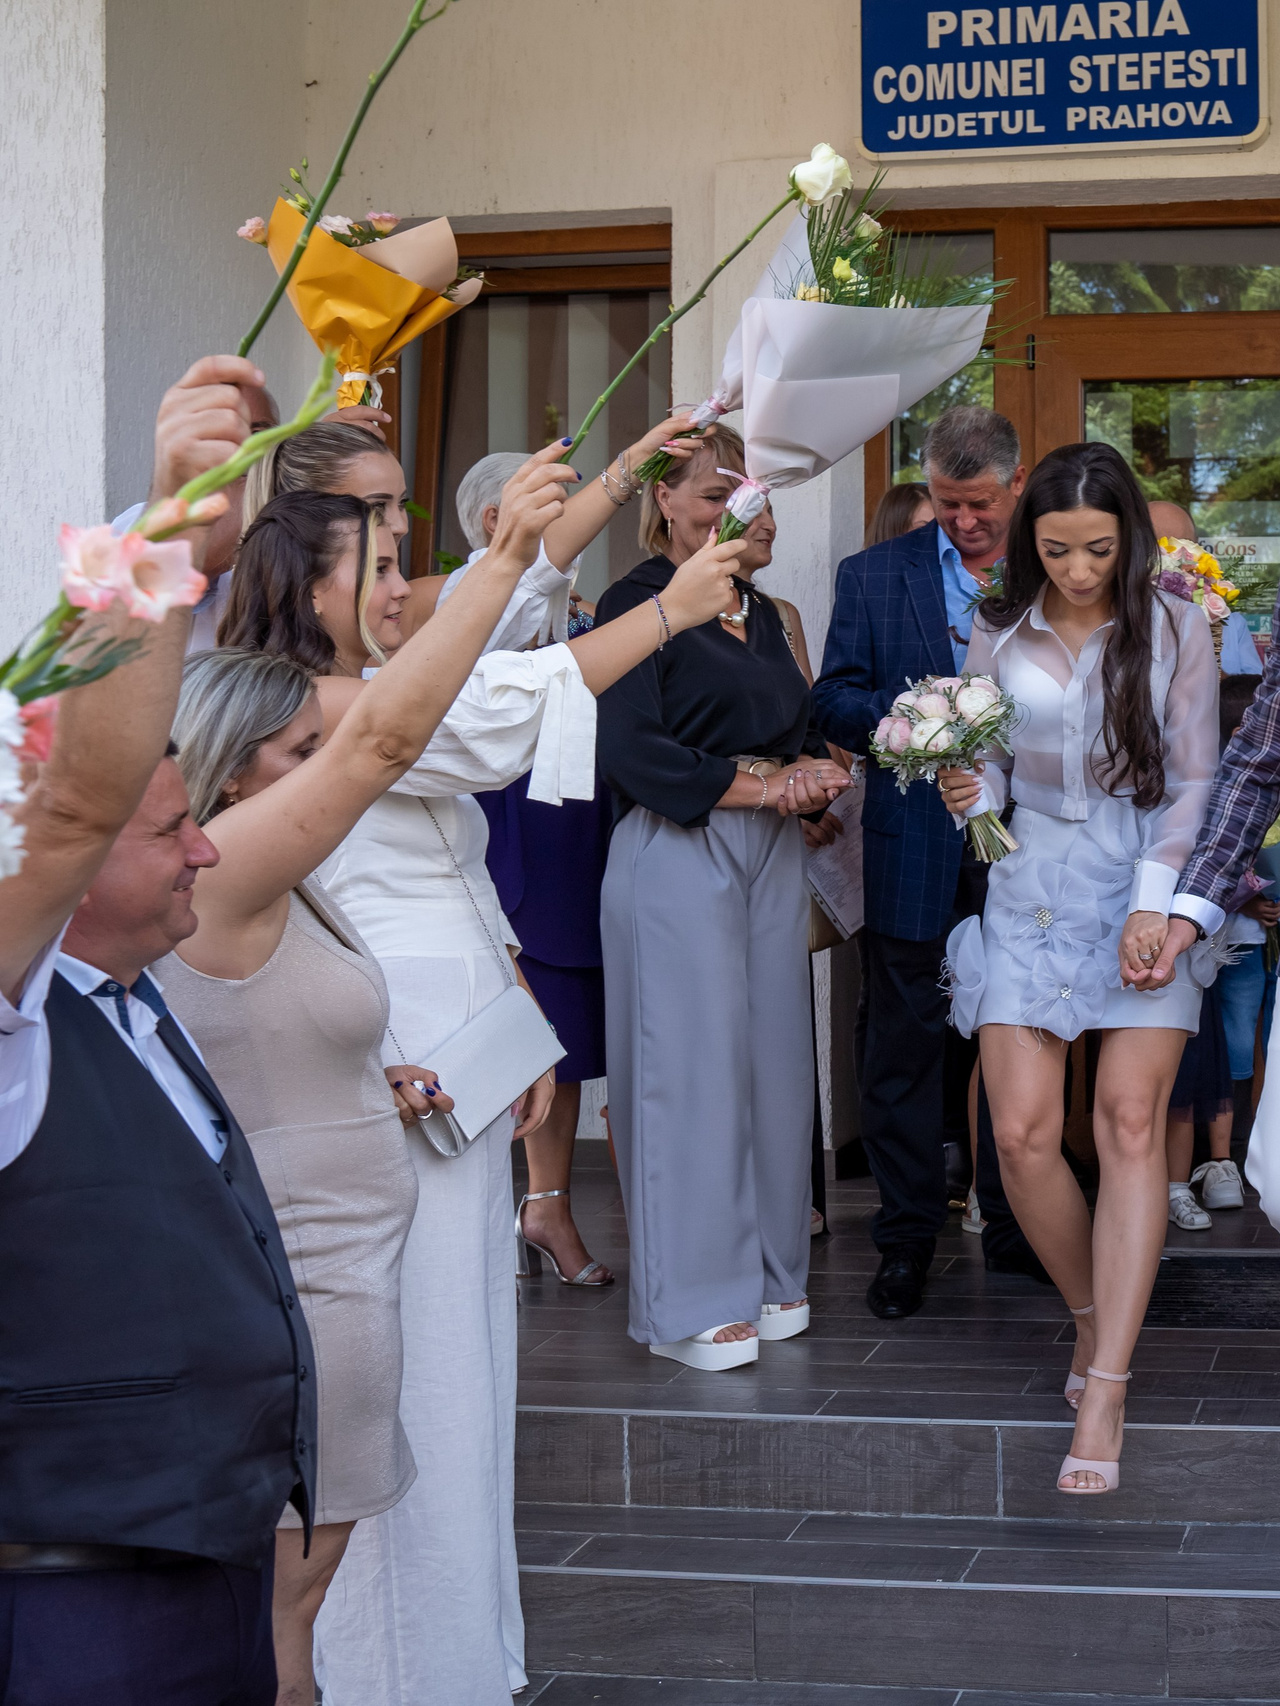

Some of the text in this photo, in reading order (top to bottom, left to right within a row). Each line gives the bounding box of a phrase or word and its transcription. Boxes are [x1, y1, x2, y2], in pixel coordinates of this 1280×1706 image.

[927, 0, 1191, 49] PRIMARIA
[873, 48, 1247, 104] COMUNEI STEFESTI
[887, 100, 1233, 141] JUDETUL PRAHOVA
